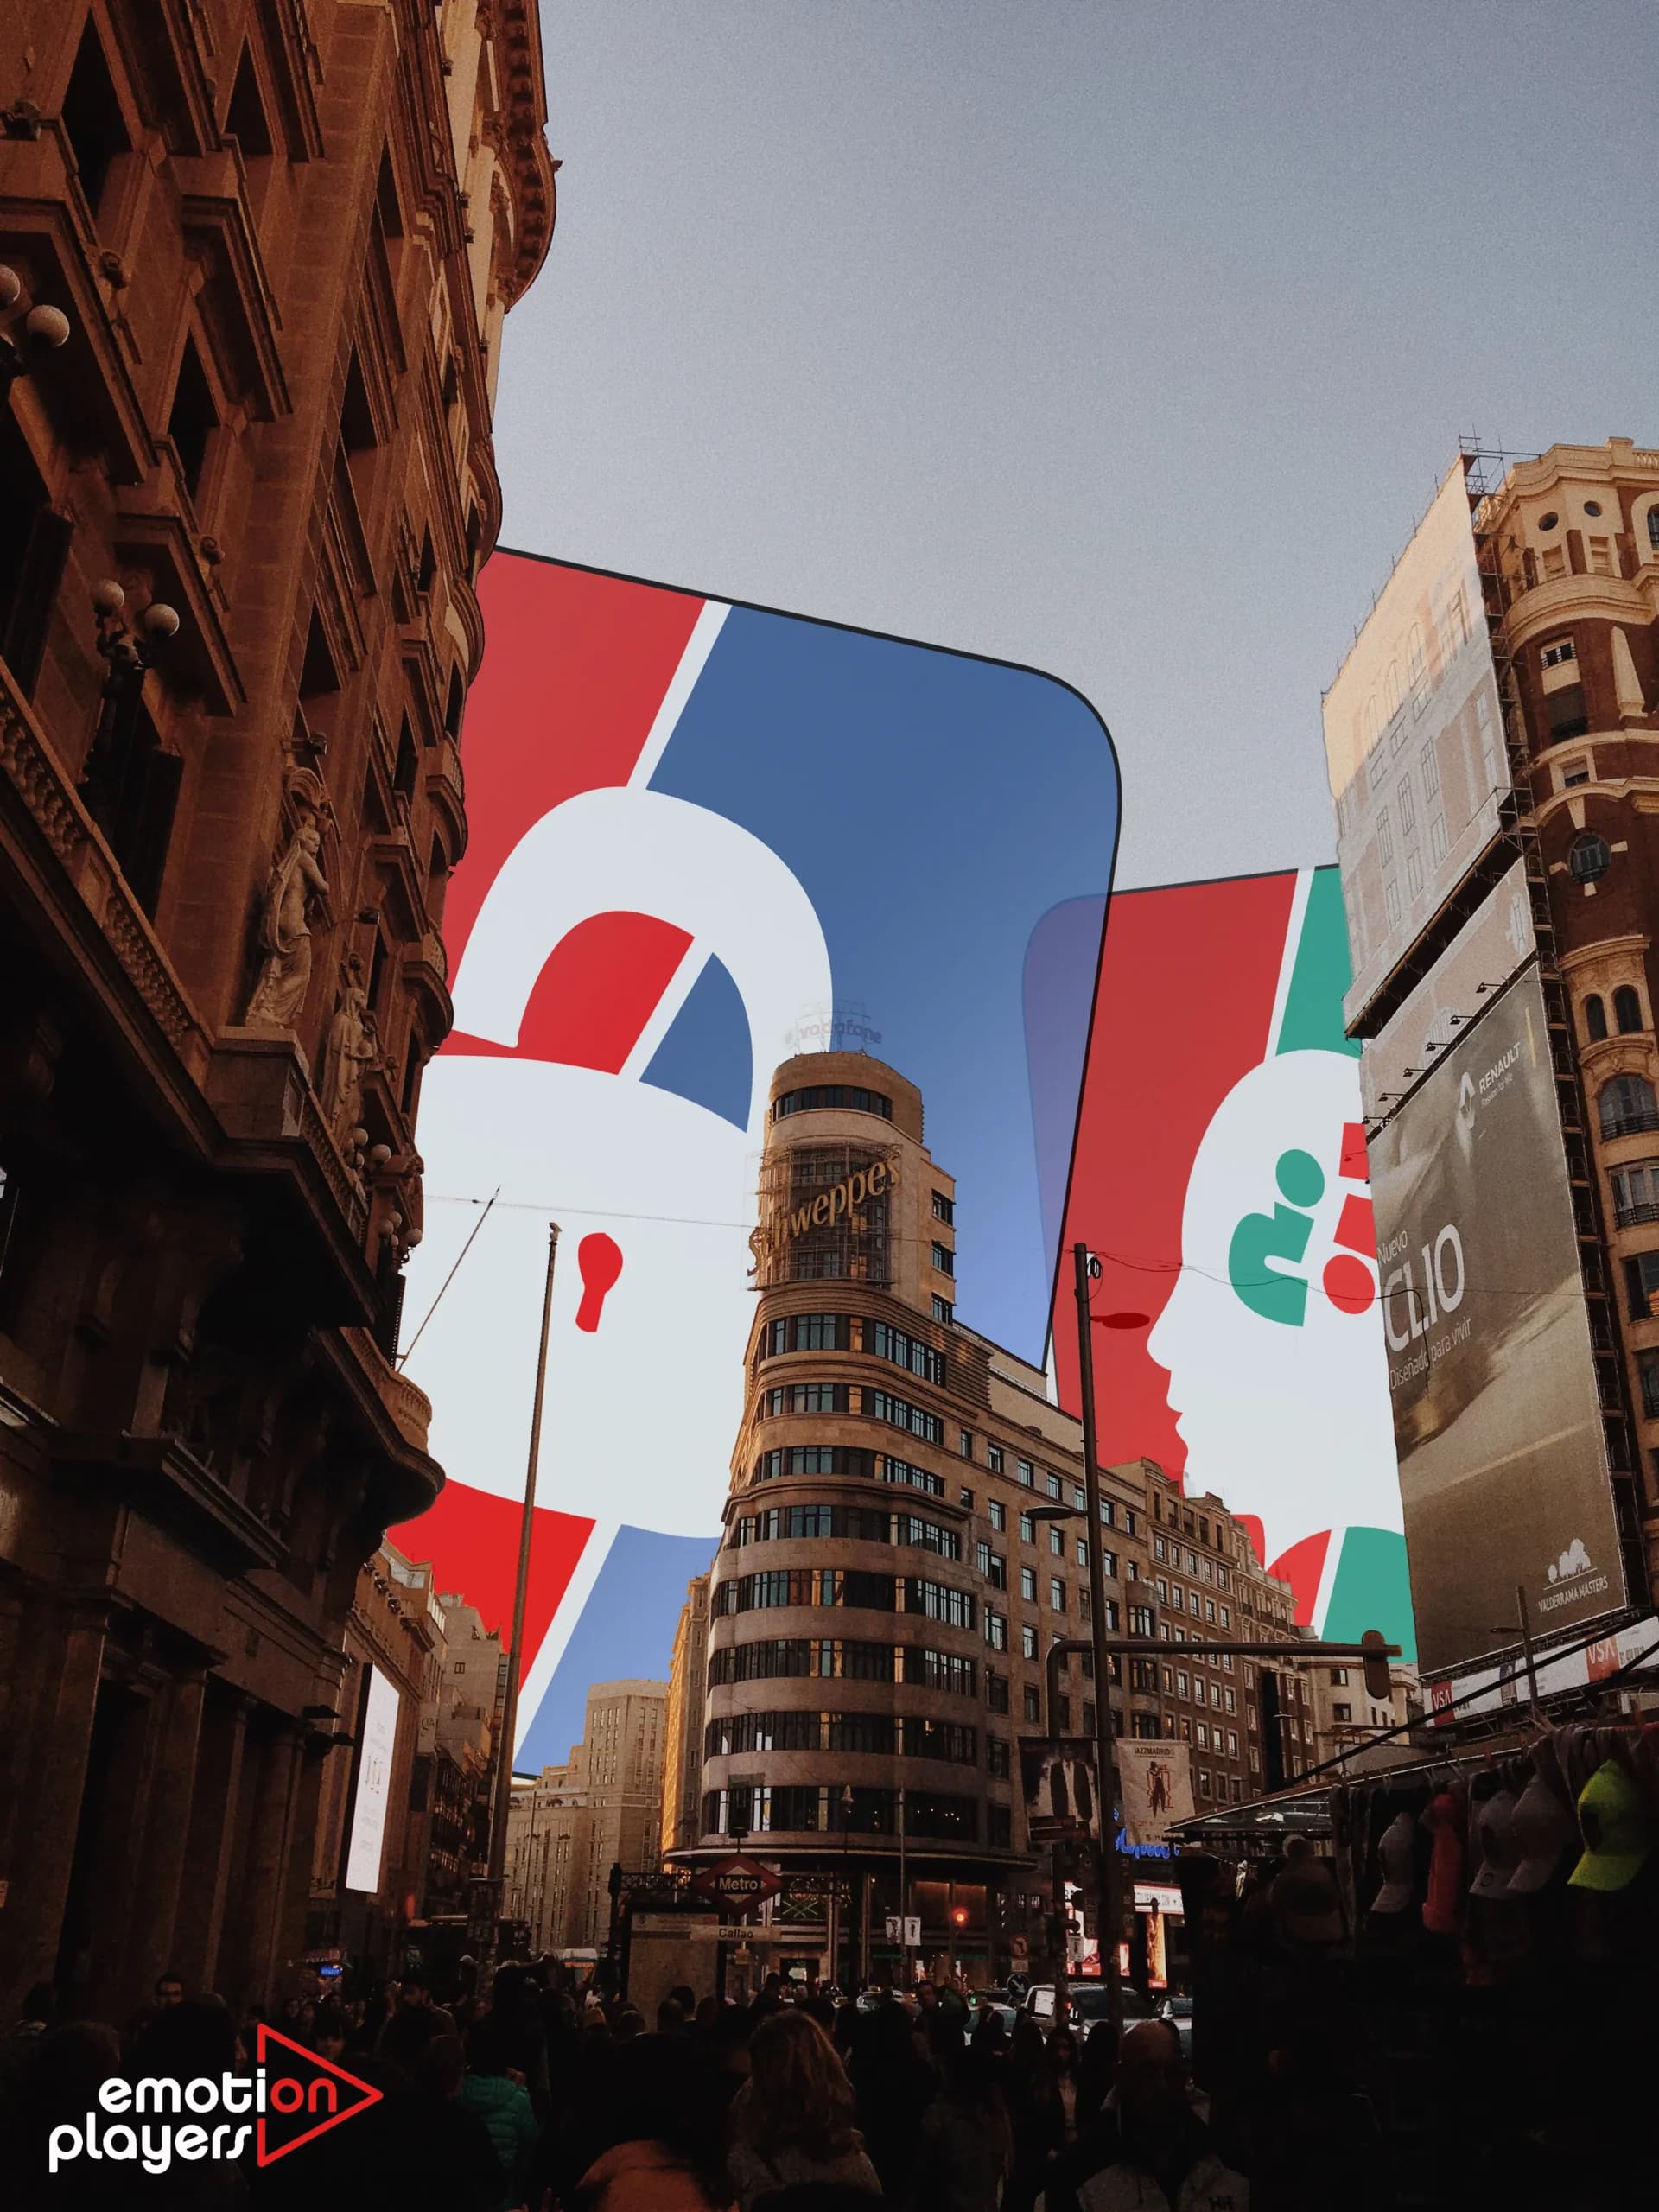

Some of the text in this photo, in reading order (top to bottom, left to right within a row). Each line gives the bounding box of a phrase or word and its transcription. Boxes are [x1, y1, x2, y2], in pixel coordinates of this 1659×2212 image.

[799, 1018, 882, 1045] vodafone
[1478, 1041, 1521, 1095] RENAULT
[1376, 1229, 1408, 1265] Nuevo
[1383, 1224, 1465, 1352] CLIO
[1389, 1316, 1471, 1390] Diseñado para vivir
[1538, 1575, 1609, 1612] VALDERRAMA MASTERS
[719, 1878, 759, 1891] Metro
[719, 1928, 753, 1939] Callao
